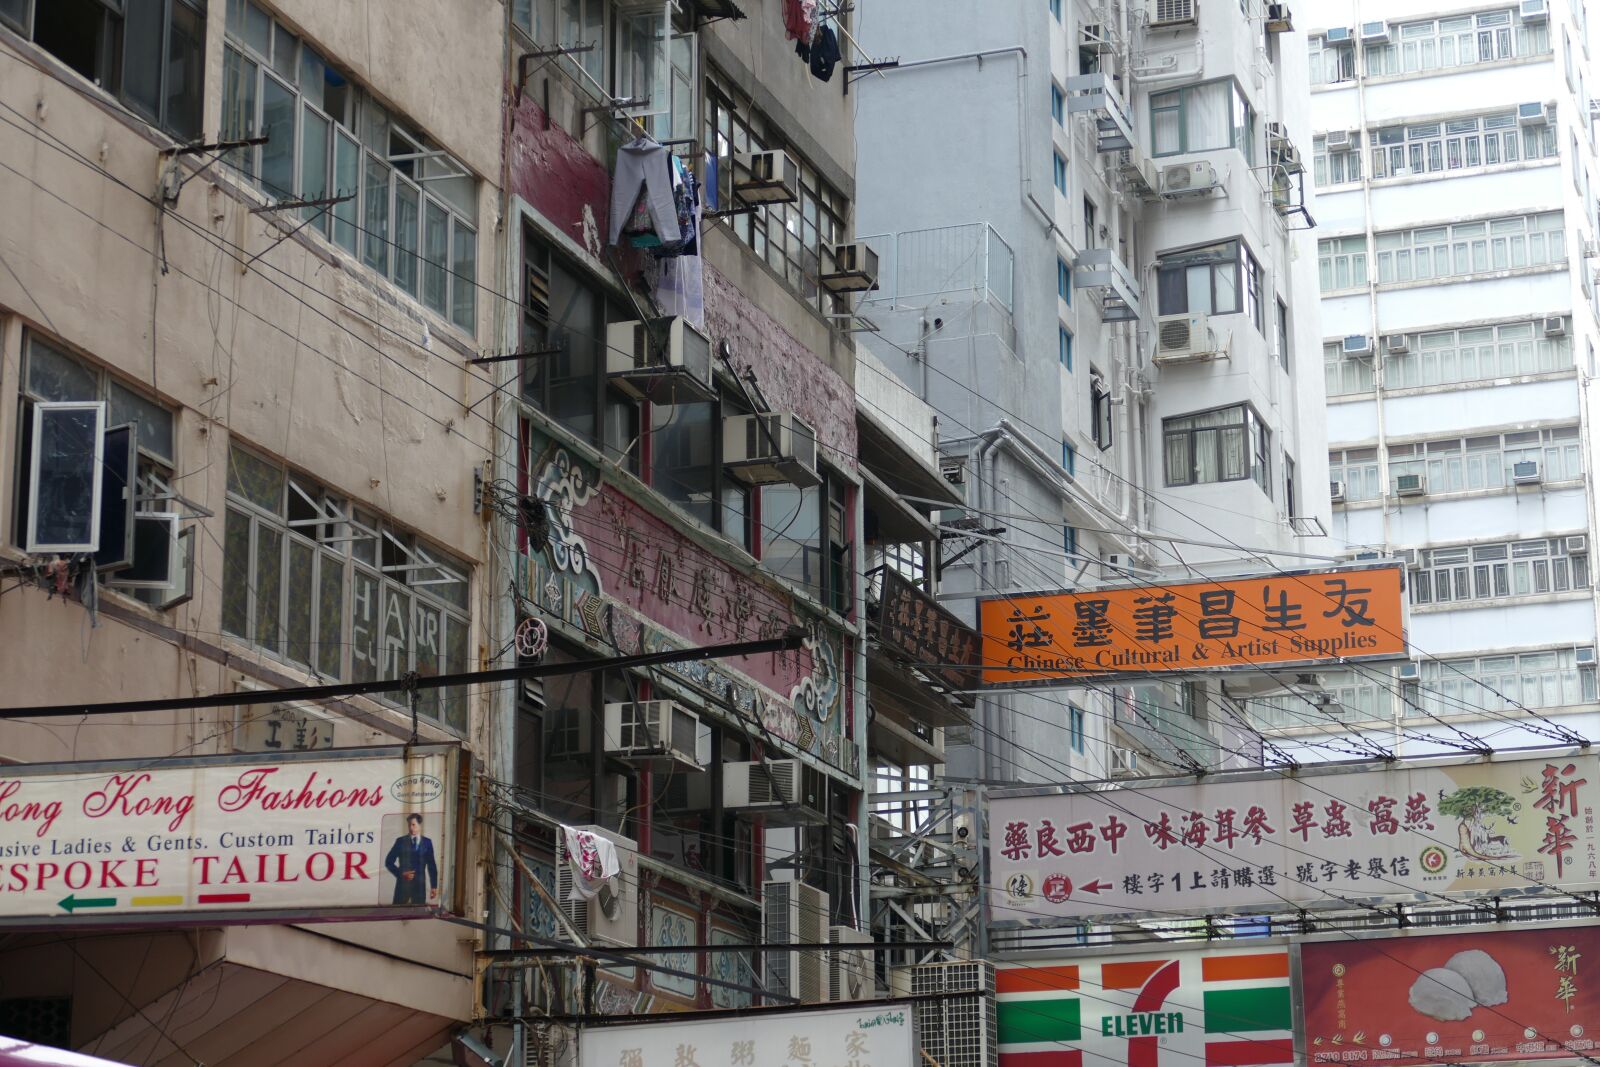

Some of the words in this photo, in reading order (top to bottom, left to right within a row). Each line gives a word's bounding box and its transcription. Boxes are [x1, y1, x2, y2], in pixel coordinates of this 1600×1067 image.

[354, 575, 438, 655] HAIR
[1007, 654, 1085, 673] Chinese
[1095, 643, 1180, 671] Cultural
[1191, 644, 1210, 661] &
[1220, 638, 1280, 659] Artist
[1290, 631, 1378, 658] Supplies
[0, 780, 63, 838] ong
[83, 773, 195, 832] Kong
[218, 767, 384, 812] Fashions
[1533, 763, 1587, 880] 新華
[51, 838, 112, 856] Ladies
[121, 836, 136, 853] &
[147, 834, 209, 852] Gents.
[219, 831, 294, 849] Custom
[305, 828, 375, 846] Tailors
[0, 857, 160, 893] SPOKE
[192, 851, 371, 886] TAILOR
